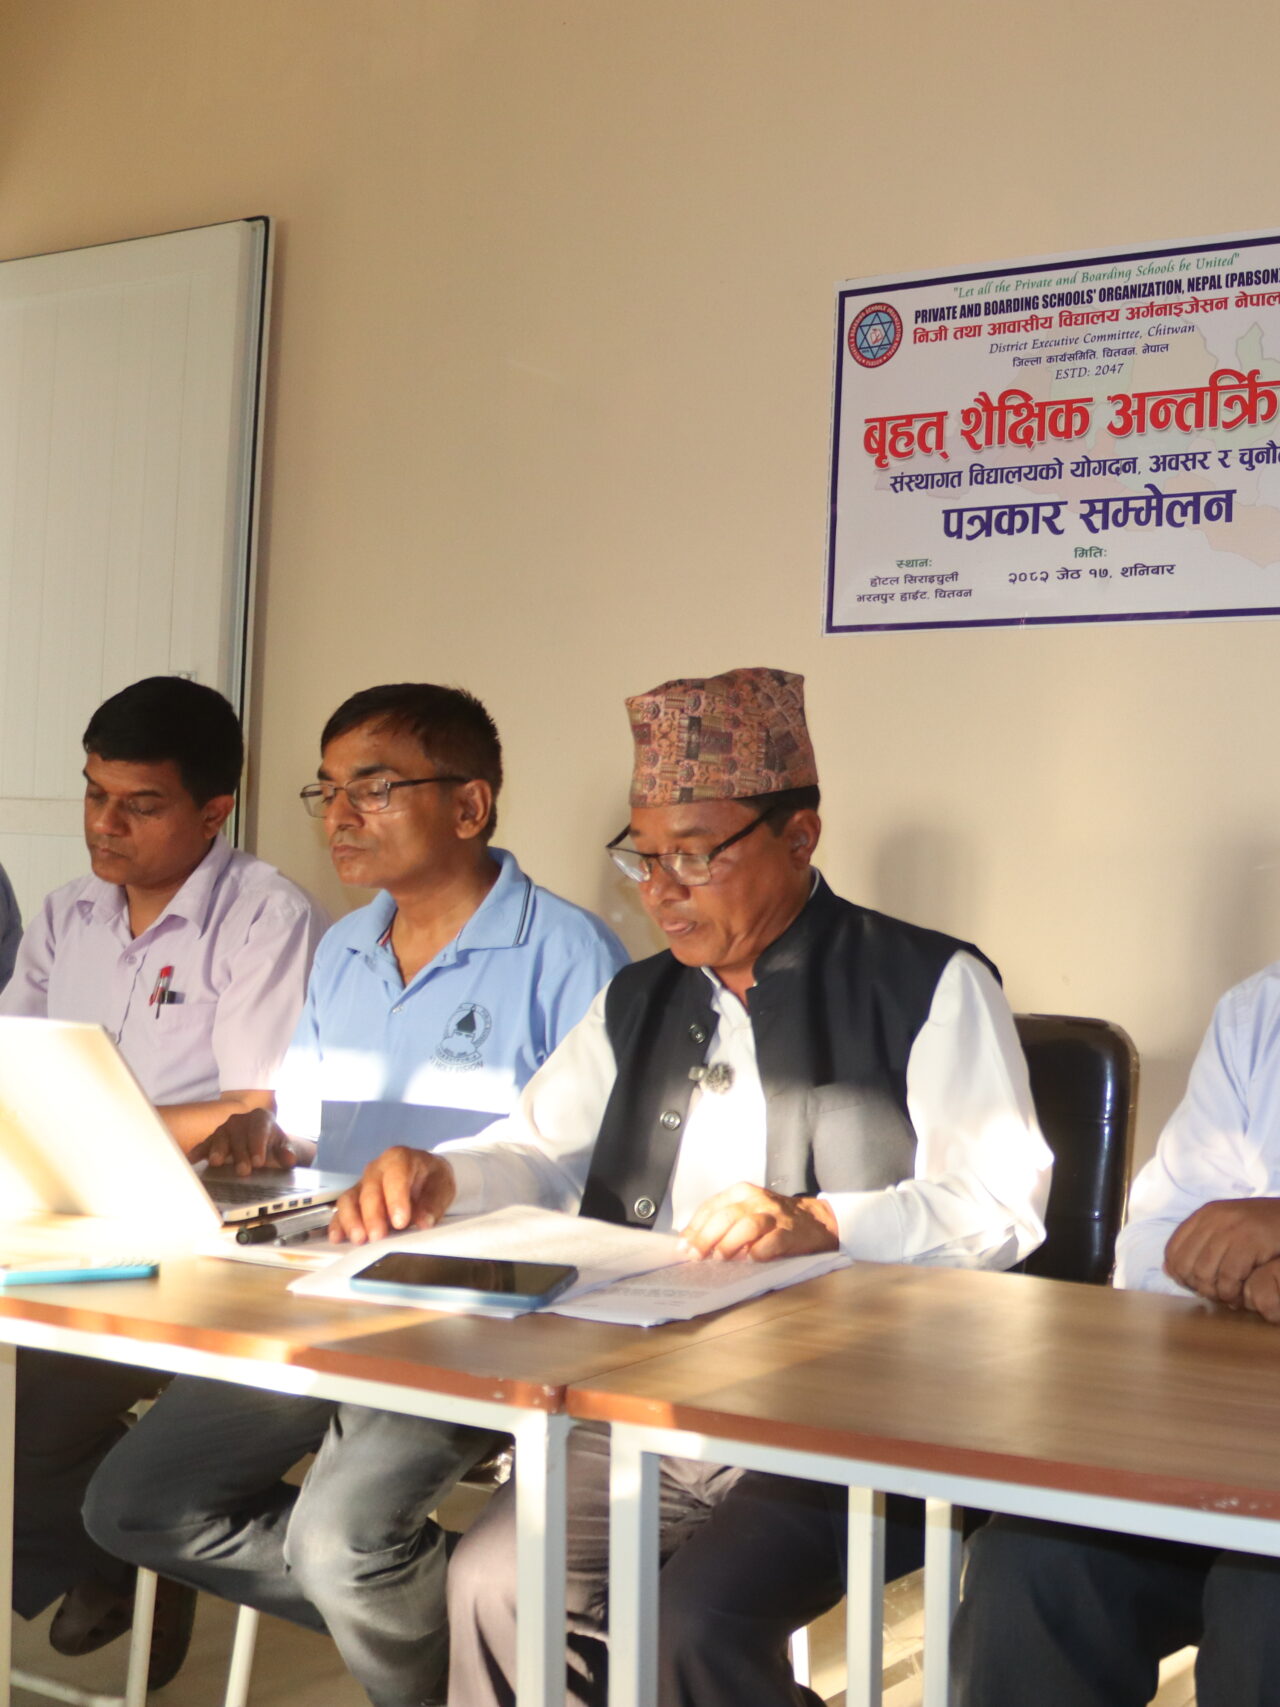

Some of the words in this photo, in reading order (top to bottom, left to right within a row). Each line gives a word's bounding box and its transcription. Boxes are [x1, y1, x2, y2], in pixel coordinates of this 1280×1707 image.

[977, 282, 992, 295] all
[995, 280, 1011, 293] the
[1014, 277, 1053, 292] Private
[1055, 271, 1078, 286] and
[1081, 266, 1132, 283] Boarding
[1135, 260, 1175, 276] Schools
[1178, 258, 1192, 272] be
[914, 305, 958, 324] PRIVATE
[959, 302, 982, 320] AND
[984, 296, 1040, 317] BOARDING
[1042, 288, 1097, 309] SCHOOLS'
[1098, 278, 1185, 303] ORGANIZATION,
[1187, 275, 1223, 293] NEPAL
[913, 324, 948, 344] निजी
[953, 322, 982, 340] तथा
[987, 312, 1053, 336] आवासीय
[1058, 309, 1121, 328] विद्यालय
[1125, 294, 1229, 321] अर्गनाइजेसन
[989, 340, 1028, 355] District
[1032, 335, 1079, 350] Executive
[1083, 330, 1142, 345] Committee,
[1147, 323, 1195, 337] Chitwan
[1012, 356, 1042, 368] जिल्ला
[1142, 343, 1169, 355] नेपाल
[1055, 366, 1091, 380] ESTD:
[1095, 362, 1125, 377] 2047
[863, 410, 950, 469] बृहत्
[960, 388, 1094, 452] शैक्षिक
[889, 470, 963, 494] संस्थागत
[968, 457, 1065, 487] विद्यालयको
[1149, 450, 1212, 473] अवसर
[1217, 449, 1233, 469] र
[942, 500, 1069, 541] पत्रकार
[1079, 483, 1237, 534] सम्मेलन
[870, 575, 900, 588] होटल
[1008, 570, 1049, 585] २०८२
[1056, 567, 1083, 581] जेठ
[1120, 562, 1177, 578] शनिवार
